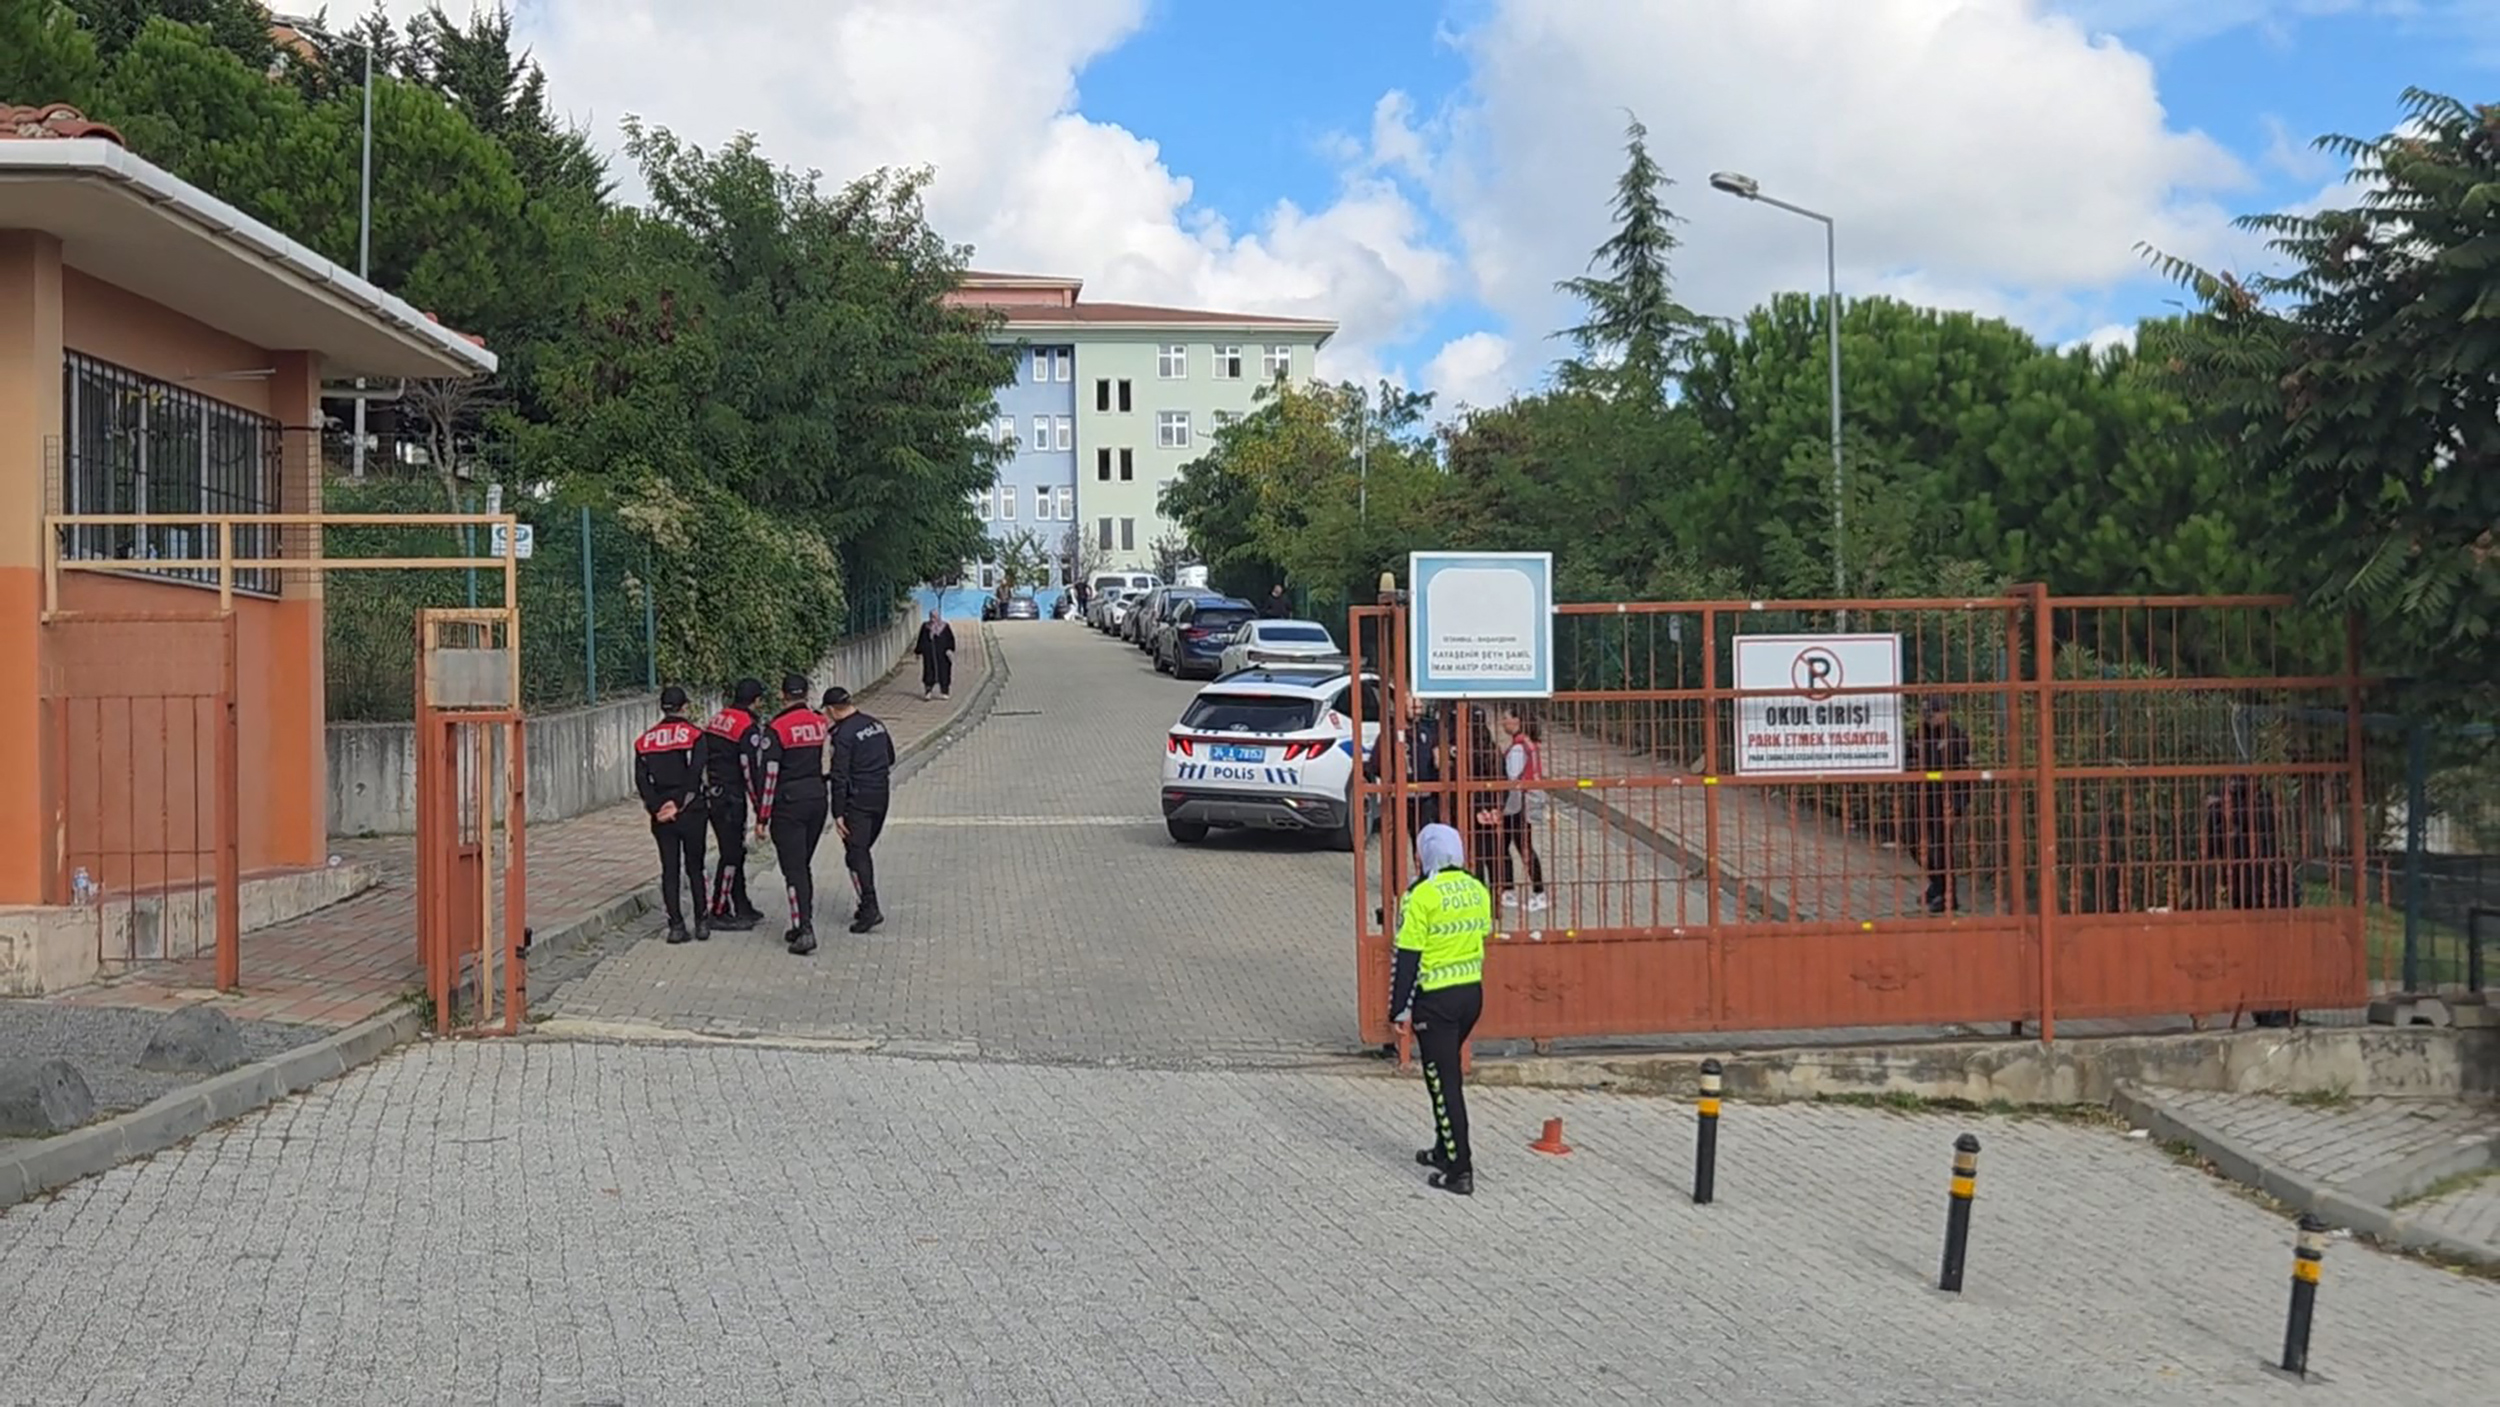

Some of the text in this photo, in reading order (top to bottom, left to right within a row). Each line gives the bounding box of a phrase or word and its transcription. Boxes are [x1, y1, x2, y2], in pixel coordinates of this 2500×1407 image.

[1766, 702, 1870, 728] OKUL GİRİŞİ
[643, 724, 690, 749] POLİS
[1748, 731, 1888, 747] PARK ETMEK YASAKTIR
[1213, 766, 1255, 780] POLİS
[1442, 892, 1481, 912] POLİS
